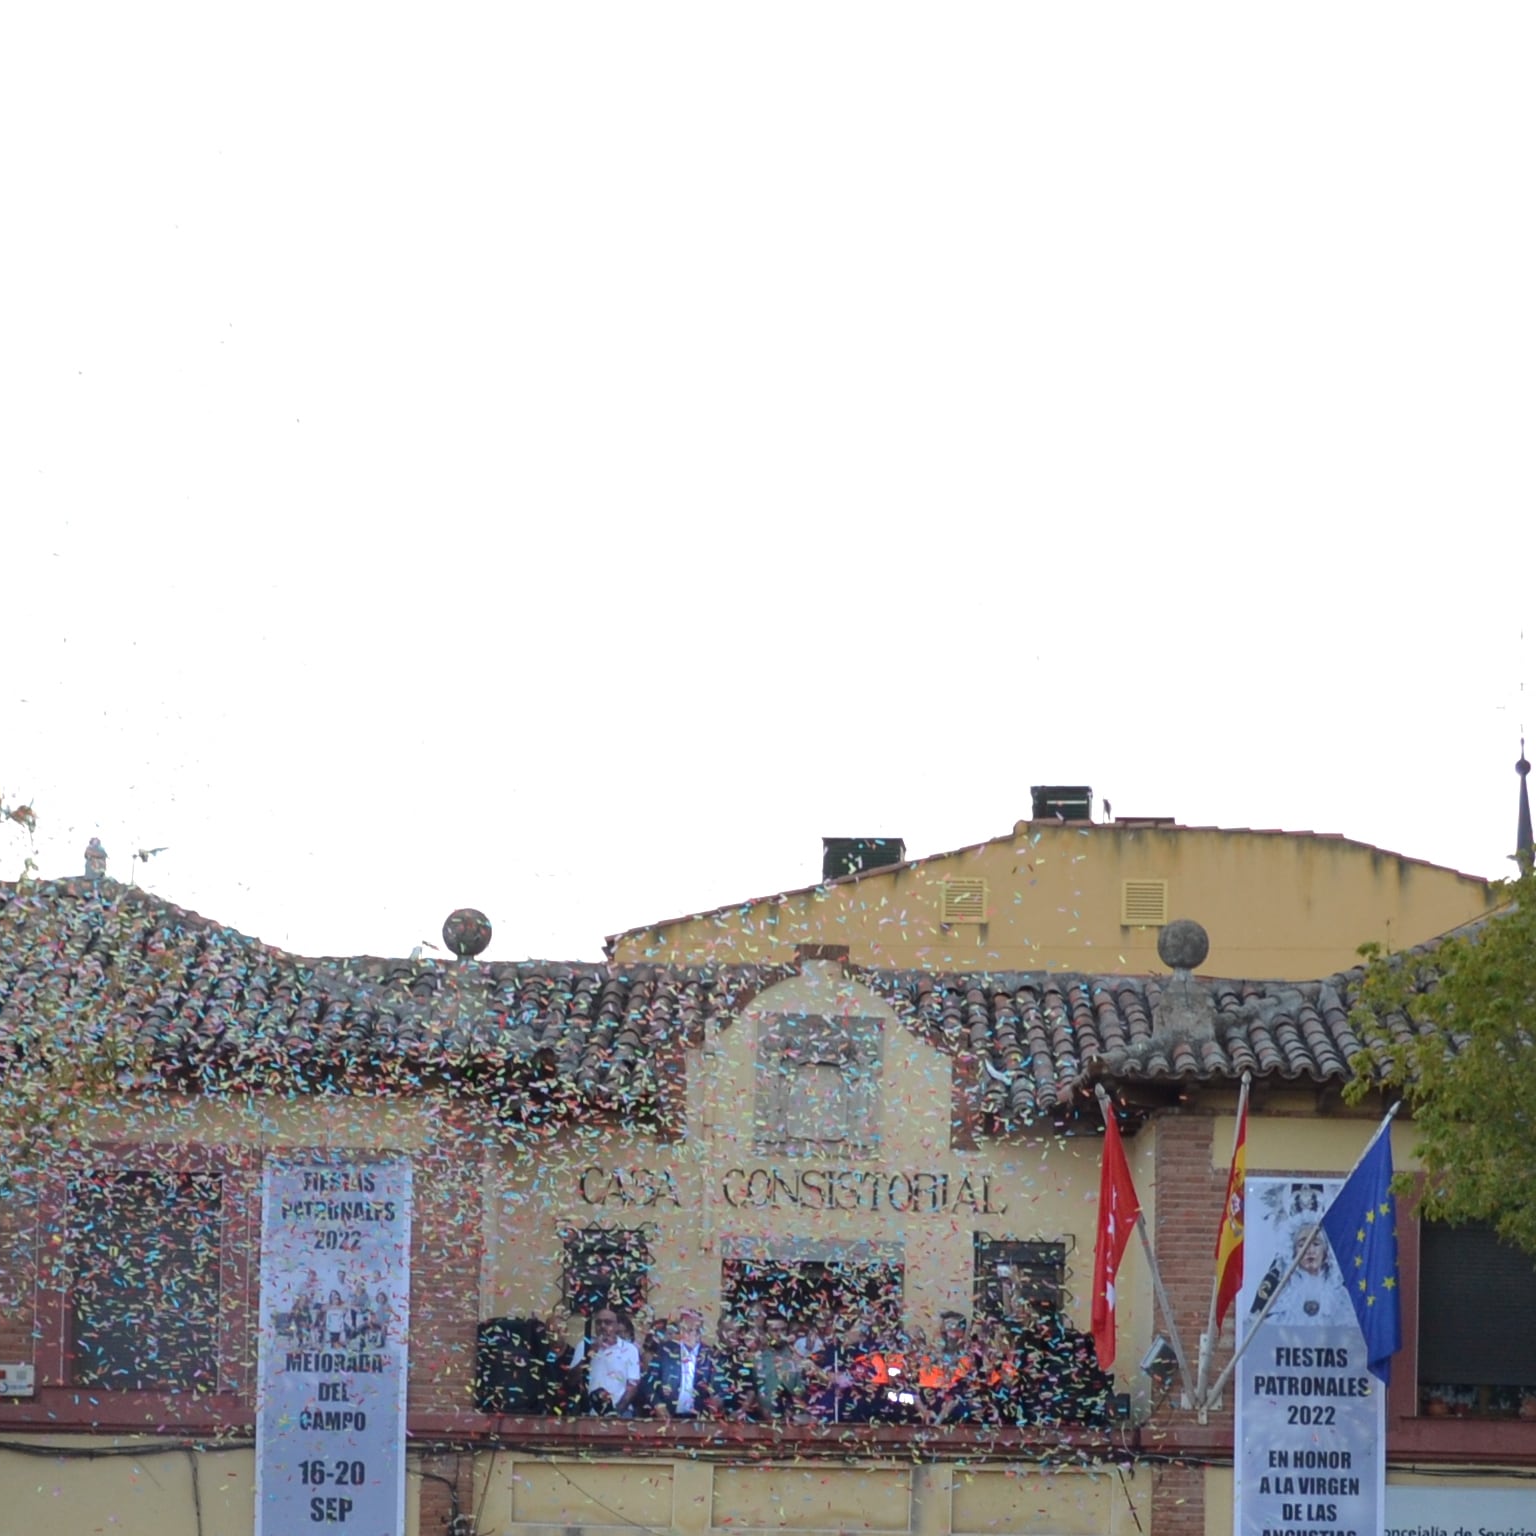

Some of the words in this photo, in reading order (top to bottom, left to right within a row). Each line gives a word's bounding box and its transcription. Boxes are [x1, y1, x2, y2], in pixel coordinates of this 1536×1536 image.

[303, 1172, 375, 1192] FIESTAS
[580, 1167, 681, 1207] CASA
[722, 1168, 1008, 1214] CONSISTORIAL
[281, 1200, 396, 1221] PATRONALES
[313, 1230, 362, 1251] 2022
[285, 1353, 383, 1374] MEJORADA
[1275, 1347, 1348, 1368] FIESTAS
[318, 1383, 350, 1403] DEL
[1254, 1375, 1369, 1397] PATRONALES
[299, 1410, 366, 1433] CAMPO
[1287, 1404, 1336, 1426] 2022
[1268, 1450, 1290, 1469] EN
[1294, 1450, 1352, 1470] HONOR
[298, 1460, 366, 1486] 16-20
[1260, 1475, 1271, 1495] A
[1274, 1475, 1295, 1495] LA
[1298, 1475, 1360, 1497] VIRGEN
[310, 1497, 353, 1523] SEP
[1282, 1502, 1304, 1522] DE
[1307, 1502, 1337, 1523] LAS
